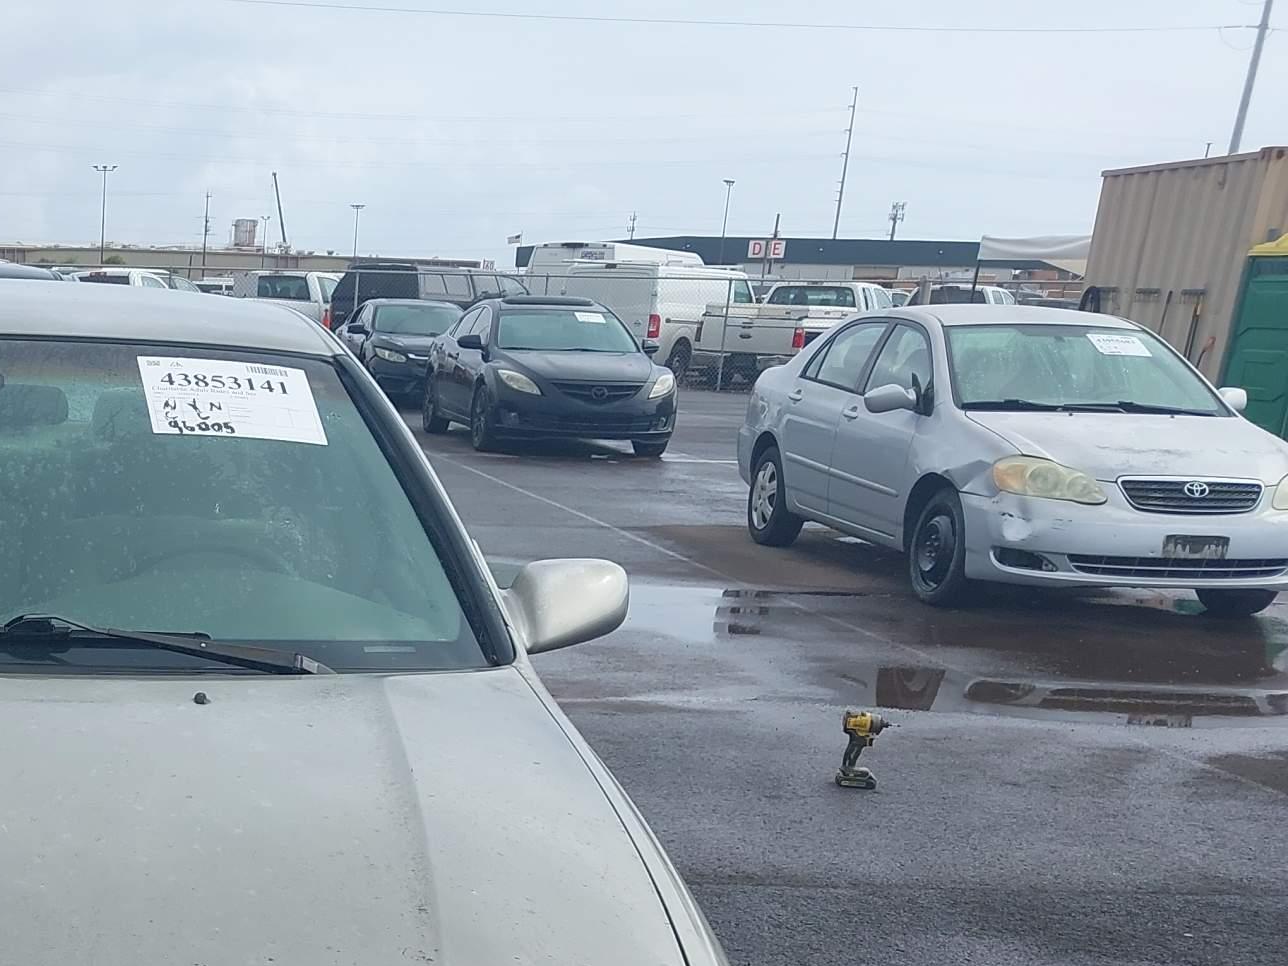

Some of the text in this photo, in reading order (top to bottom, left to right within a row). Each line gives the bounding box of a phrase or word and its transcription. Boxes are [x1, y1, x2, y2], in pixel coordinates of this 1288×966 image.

[753, 243, 782, 255] D E
[160, 372, 288, 395] 43853141
